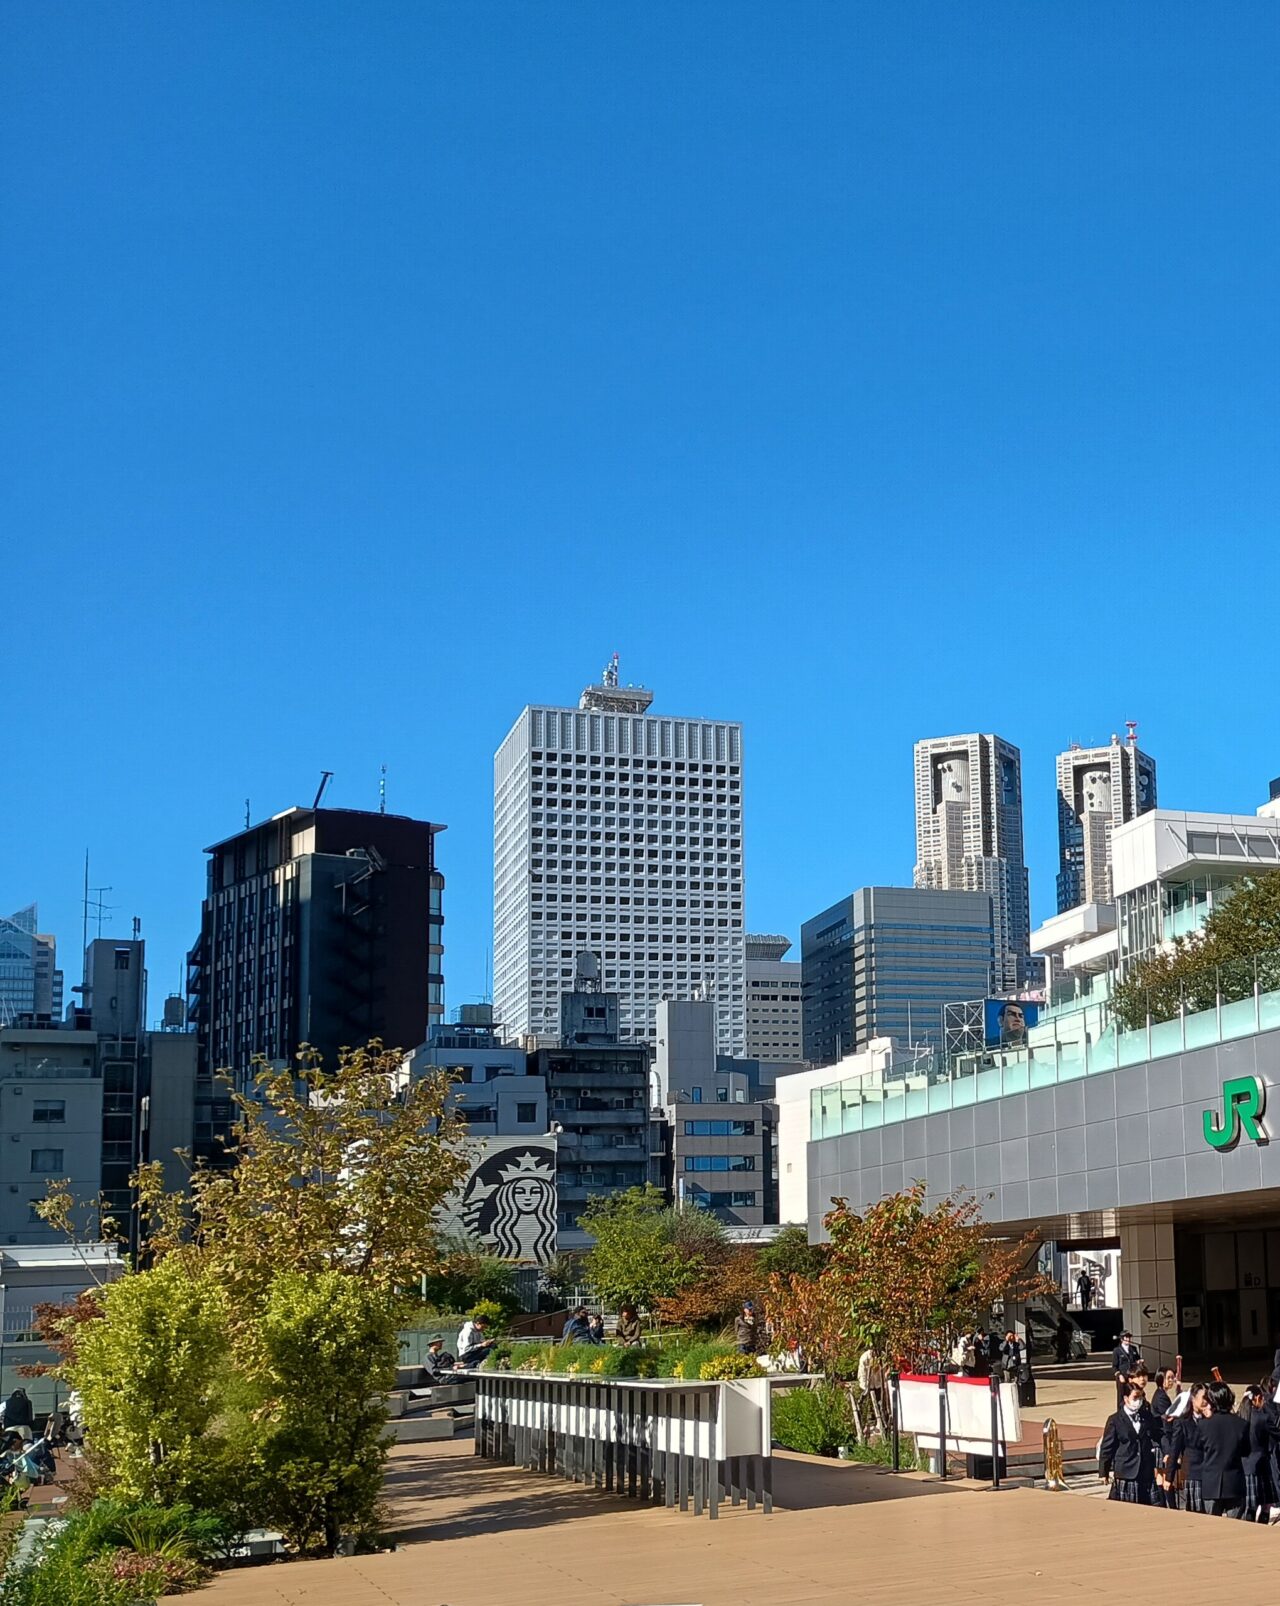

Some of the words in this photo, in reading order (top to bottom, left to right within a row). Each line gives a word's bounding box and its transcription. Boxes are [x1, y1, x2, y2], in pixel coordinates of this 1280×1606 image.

[1203, 1075, 1269, 1148] JR
[1147, 1321, 1171, 1329] スロープ
